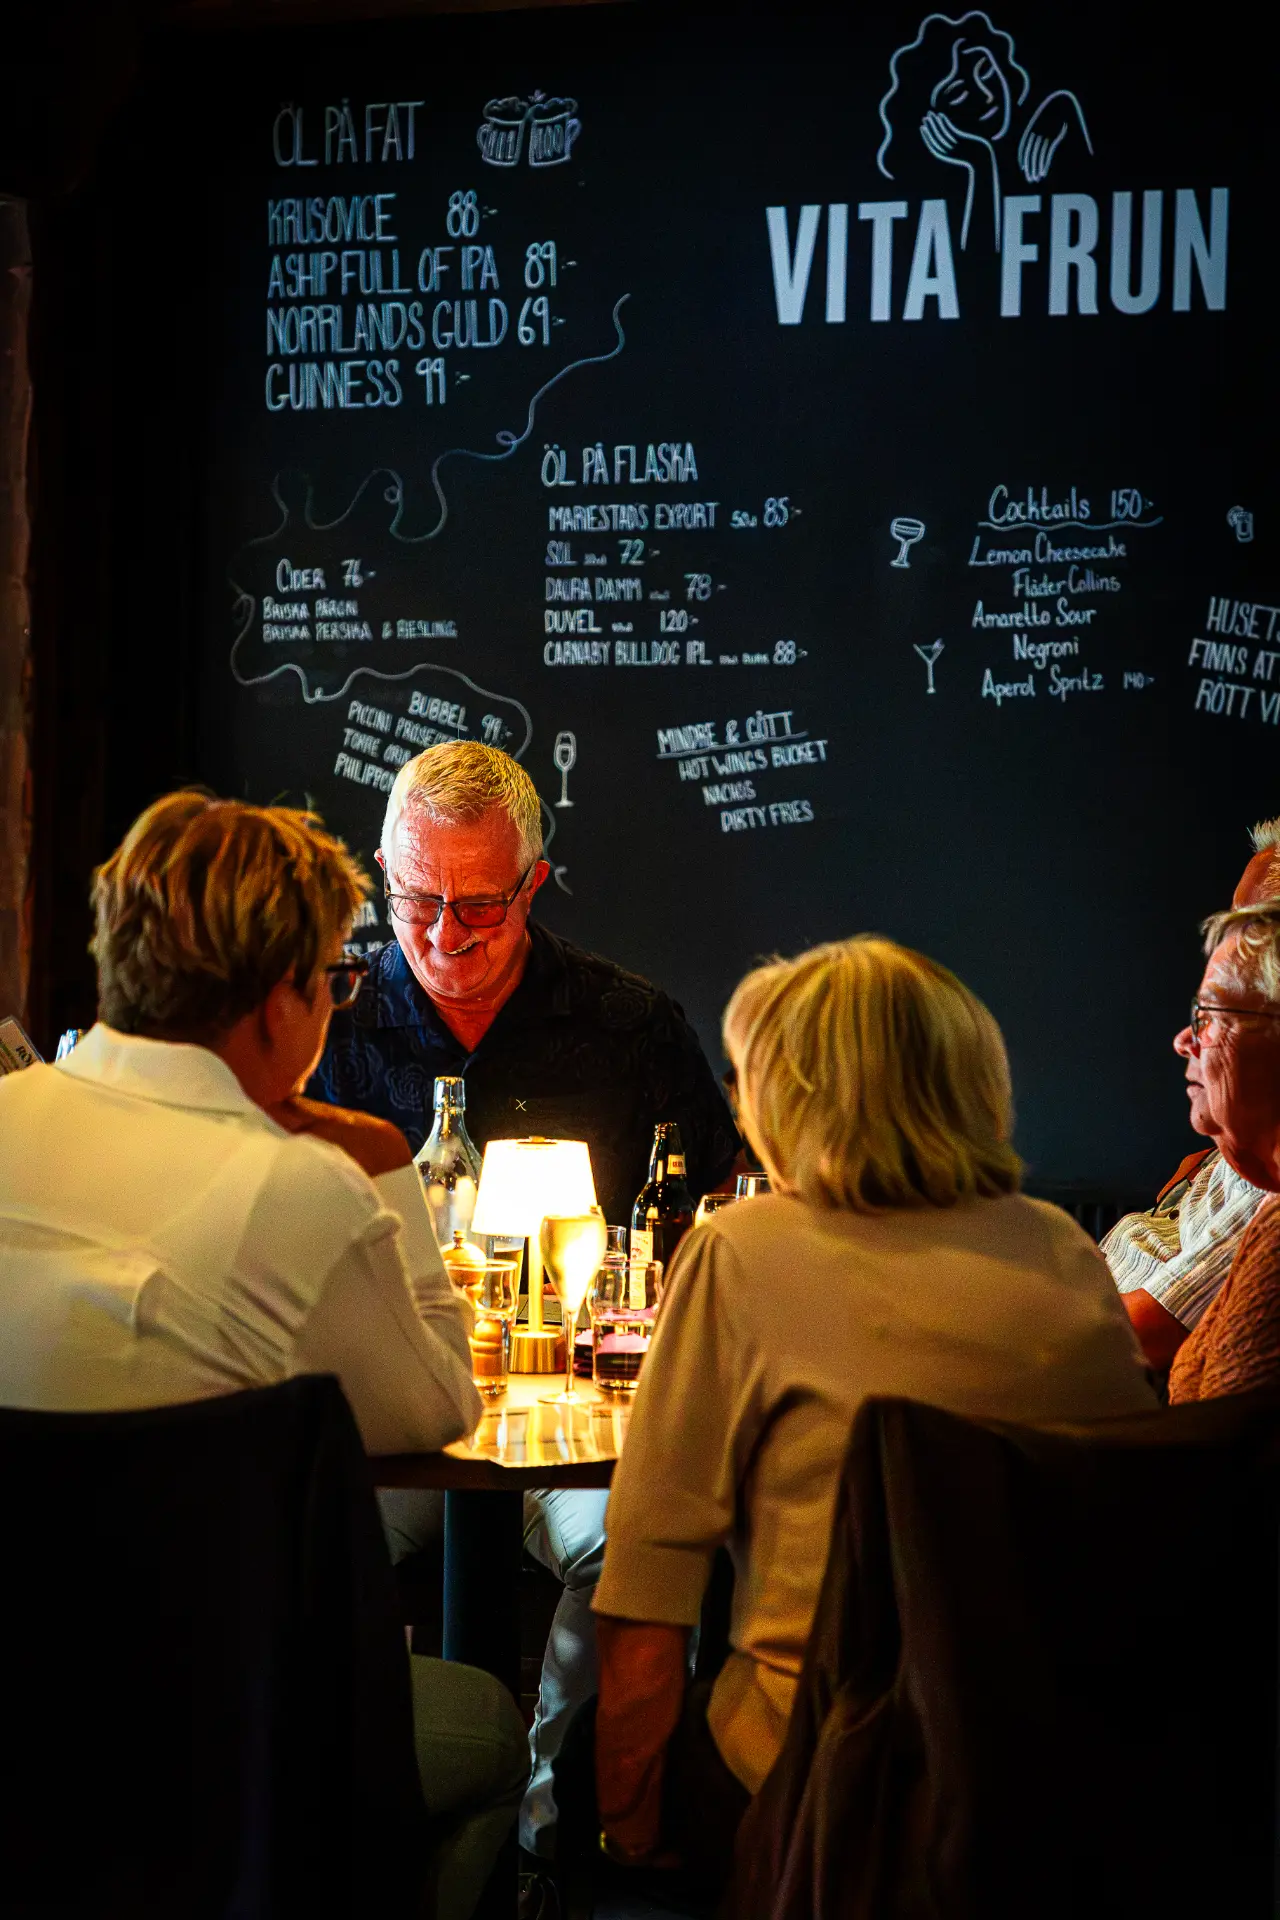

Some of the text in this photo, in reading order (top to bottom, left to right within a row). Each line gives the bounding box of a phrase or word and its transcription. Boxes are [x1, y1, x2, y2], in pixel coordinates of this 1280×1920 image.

[273, 98, 425, 167] ÖL PÅ FAT
[267, 193, 397, 246] KRUSOVICE
[341, 248, 413, 296] FULL
[418, 247, 456, 292] OF
[461, 245, 499, 290] IPA
[766, 187, 1230, 325] VITA FRUN
[266, 302, 425, 356] NORRLANDS
[432, 299, 508, 350] GULD
[265, 359, 402, 411] GUINNESS
[541, 442, 698, 487] ÖL PÅ FLASKA
[549, 502, 649, 532] MARIESTADS
[654, 502, 720, 530] EXPORT
[988, 485, 1090, 523] Cocktails
[545, 540, 578, 567] SOL
[968, 531, 1127, 566] Lemon Cheesecake
[545, 577, 592, 601] DAURA
[595, 577, 643, 601] DAMM
[1067, 565, 1121, 594] Collins
[544, 609, 602, 634] DUVEL
[972, 598, 1097, 628] Amaretto Sour
[614, 640, 680, 666] BULLDOG
[1013, 634, 1079, 670] Negroni
[1187, 637, 1249, 676] FINNS
[981, 668, 1036, 706] Aperol
[1049, 664, 1105, 702] Spritz
[408, 691, 469, 732] BUBBEL
[657, 721, 717, 755] MINDRE
[726, 719, 740, 745] &
[678, 740, 828, 782] HOT WINGS BUCKET
[720, 800, 814, 833] DIRTY FRIES
